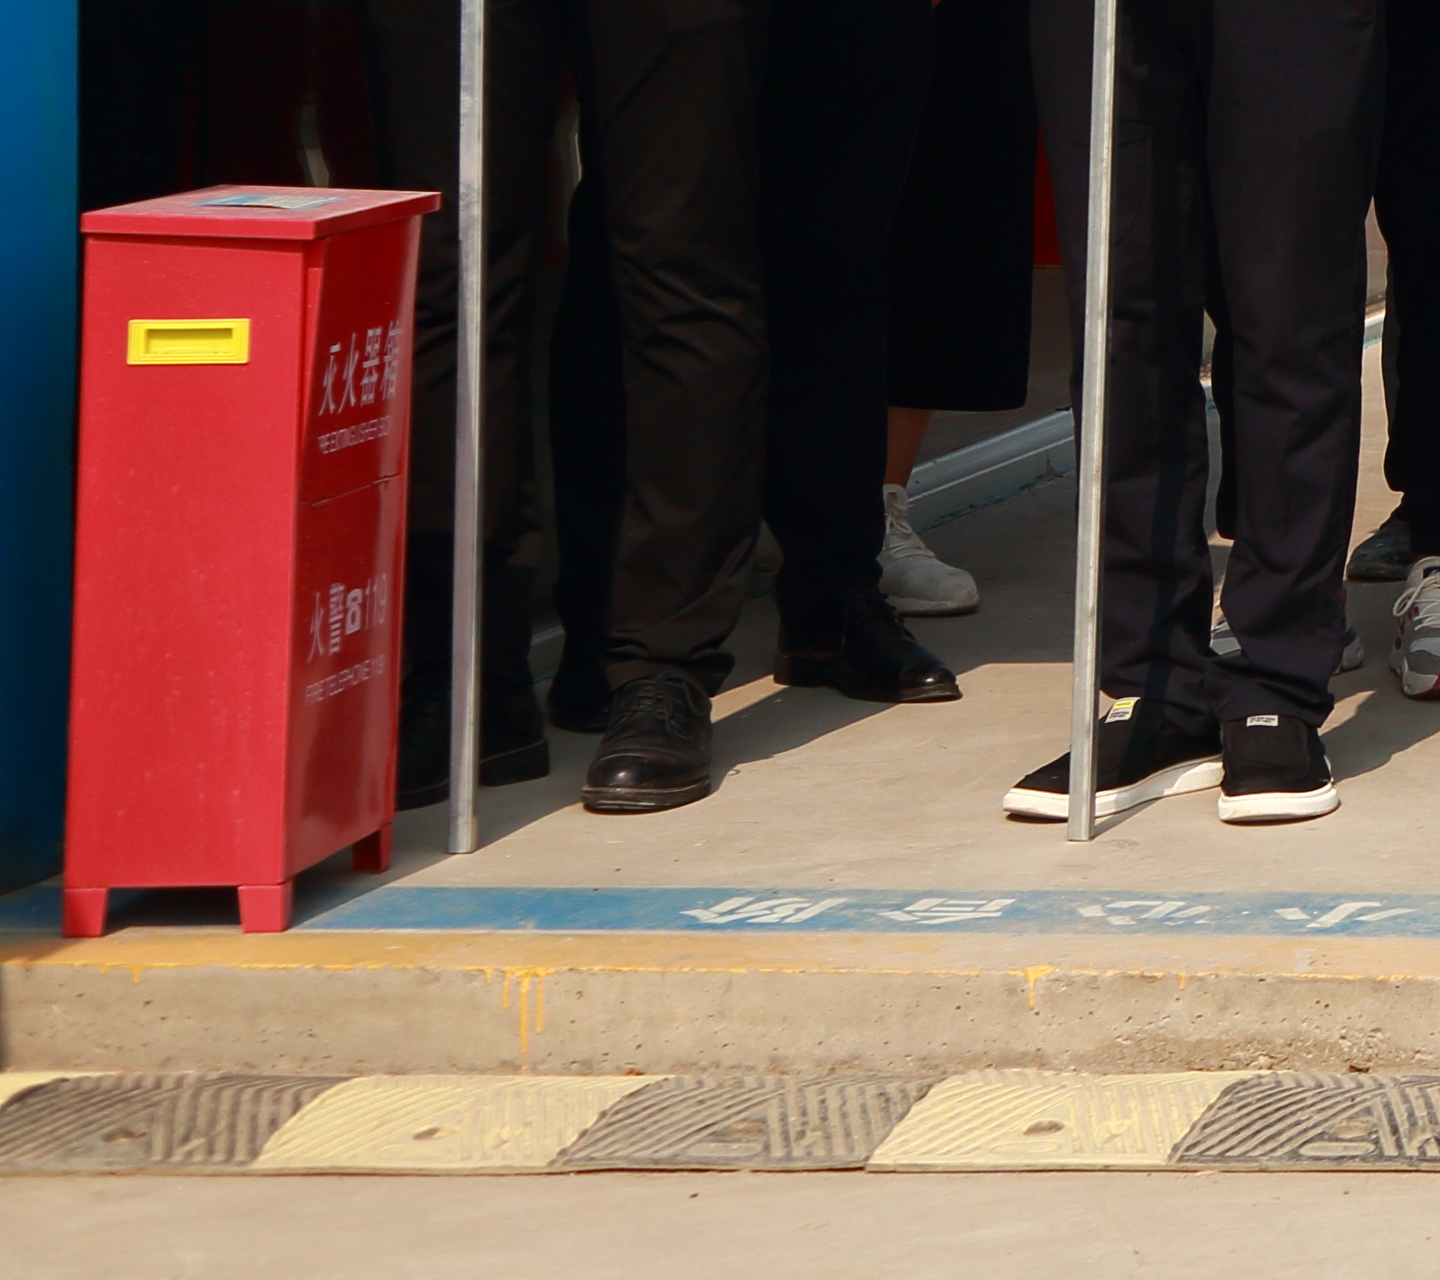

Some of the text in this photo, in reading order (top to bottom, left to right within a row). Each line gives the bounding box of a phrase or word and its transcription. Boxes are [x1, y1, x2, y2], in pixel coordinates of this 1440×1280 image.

[318, 319, 403, 417] 灭火器箱
[307, 582, 345, 664] 火警
